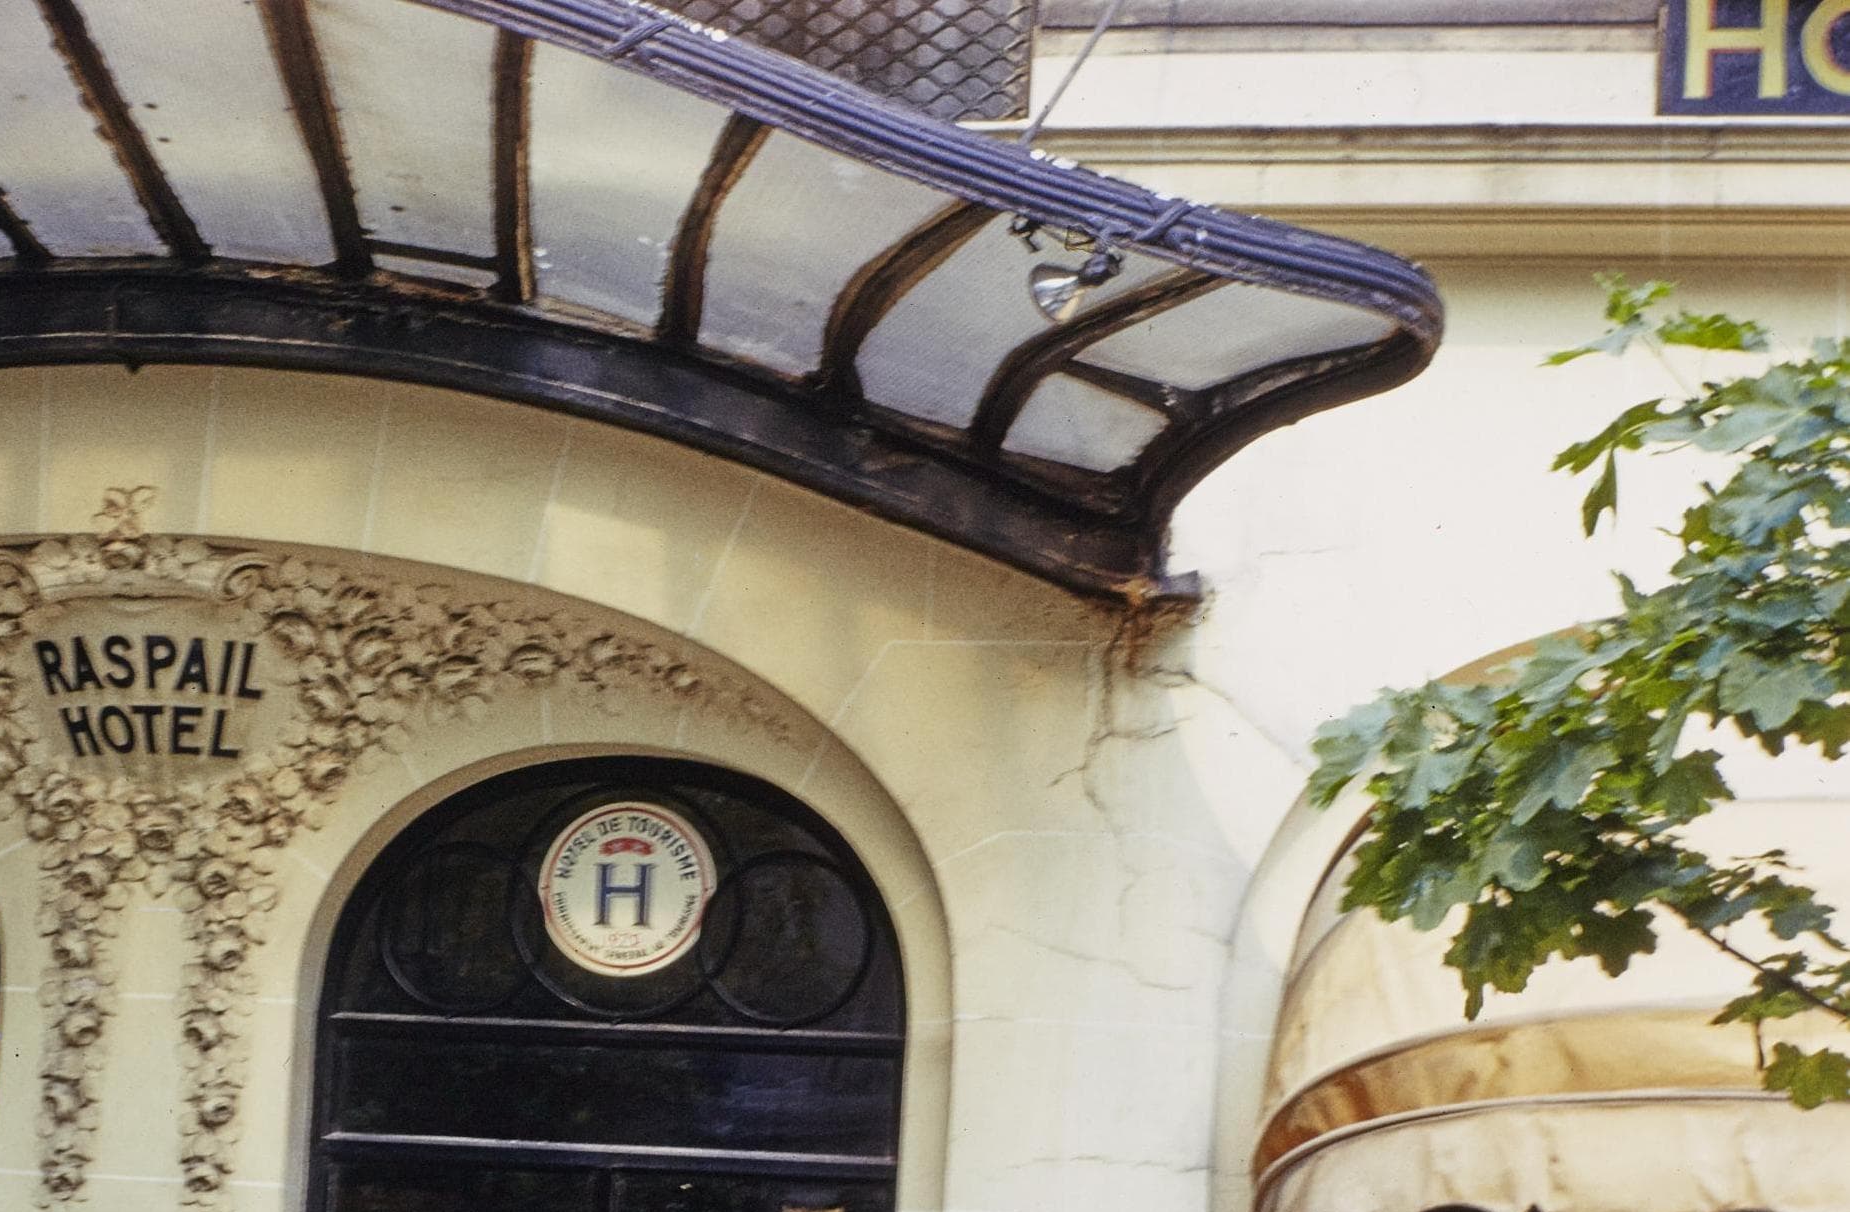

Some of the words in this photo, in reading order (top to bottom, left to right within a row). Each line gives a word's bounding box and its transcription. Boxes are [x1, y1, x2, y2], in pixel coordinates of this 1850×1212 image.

[34, 634, 266, 700] RASPAIL
[60, 704, 242, 759] HOTEL
[593, 862, 657, 927] H
